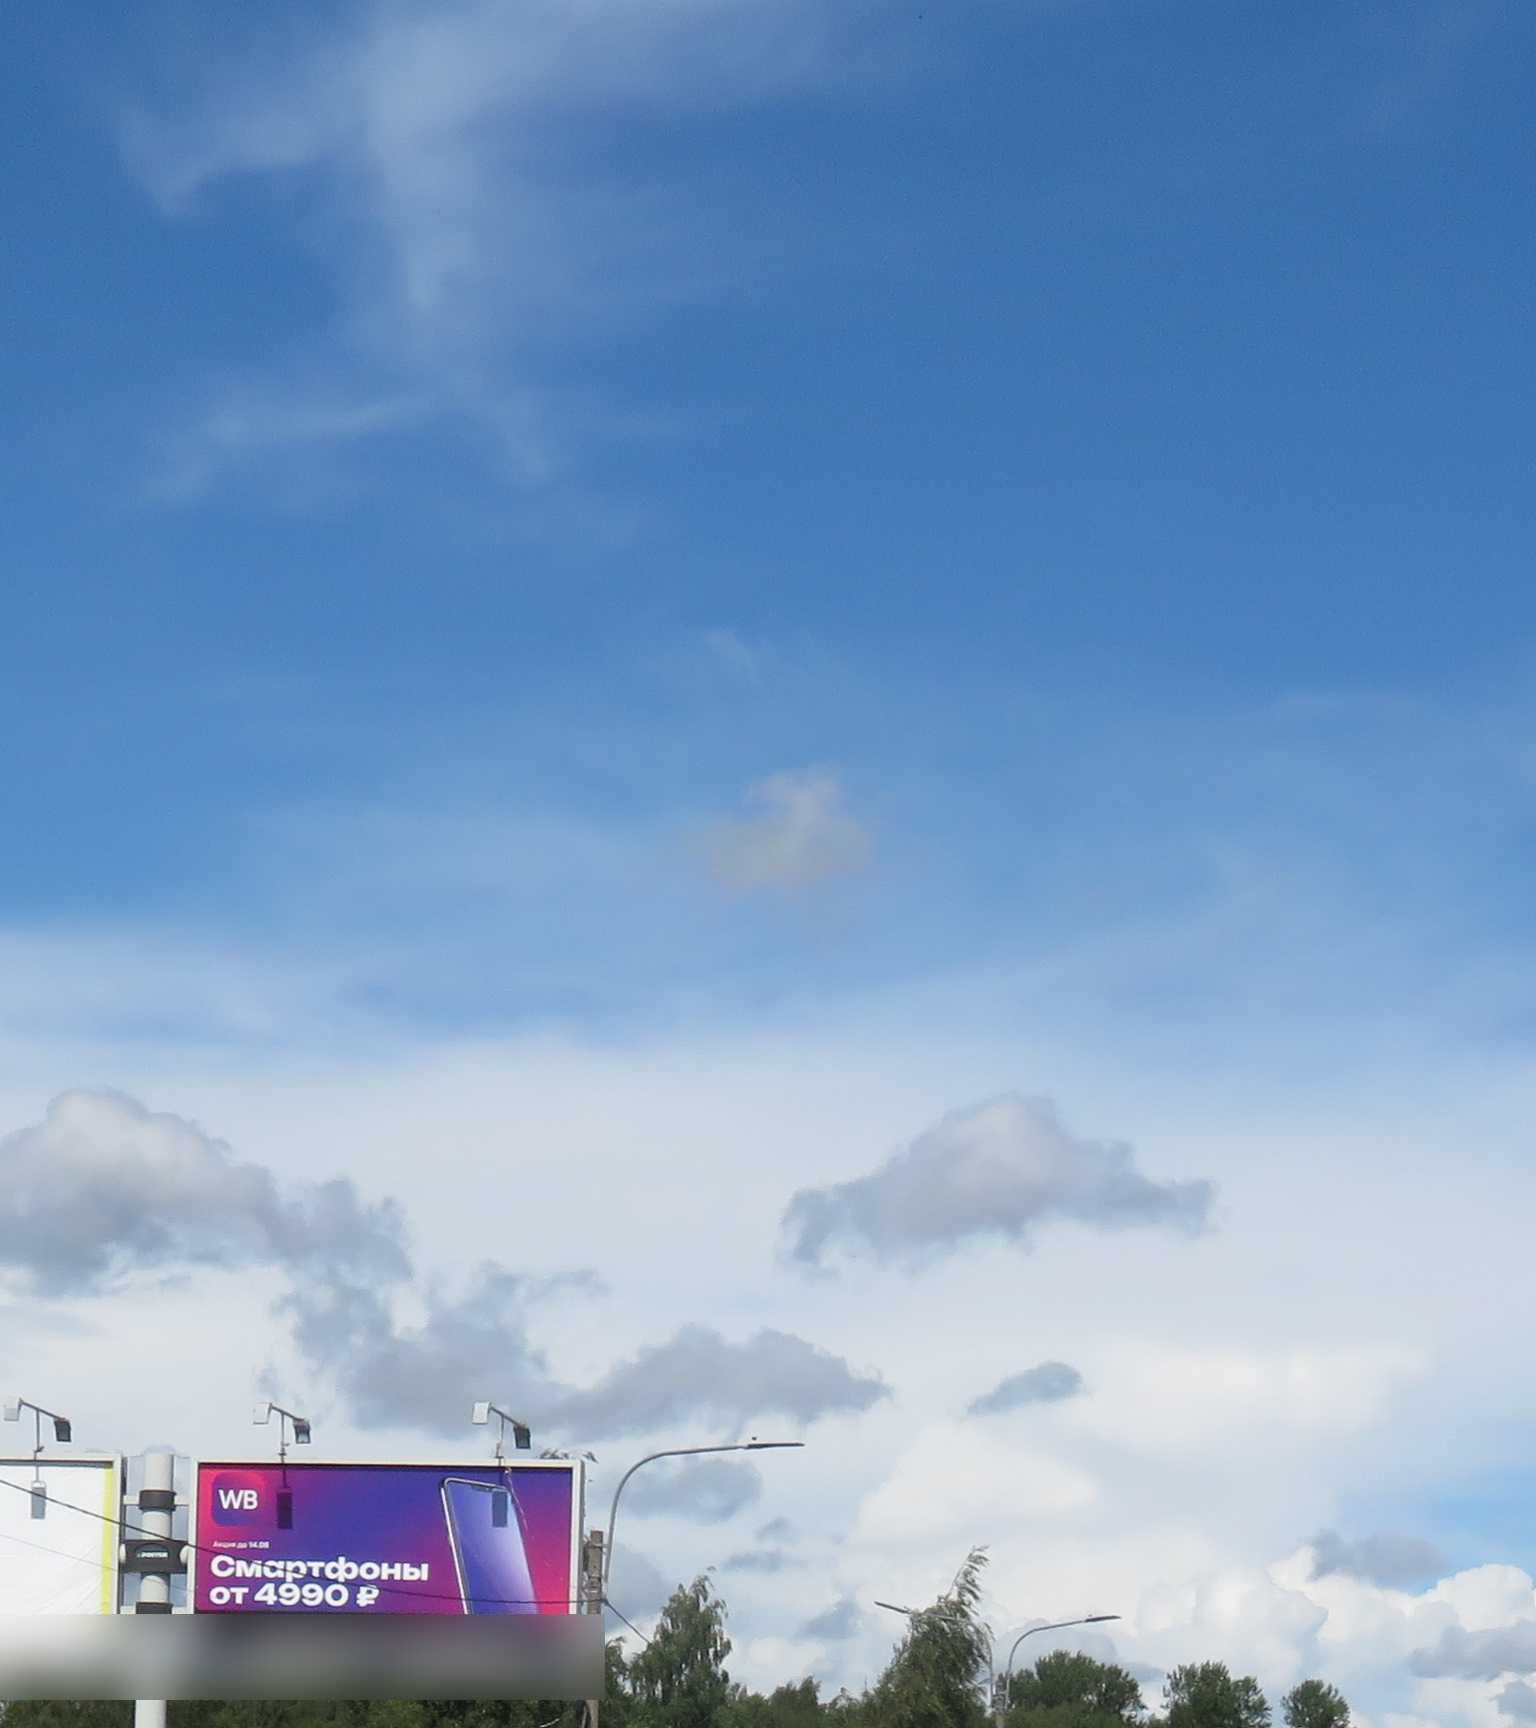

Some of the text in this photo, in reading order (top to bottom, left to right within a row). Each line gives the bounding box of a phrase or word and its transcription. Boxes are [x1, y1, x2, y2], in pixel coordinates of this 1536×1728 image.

[219, 1489, 258, 1510] WB
[210, 1554, 429, 1582] Смартфоны
[209, 1586, 249, 1605] от
[254, 1582, 349, 1607] 4990
